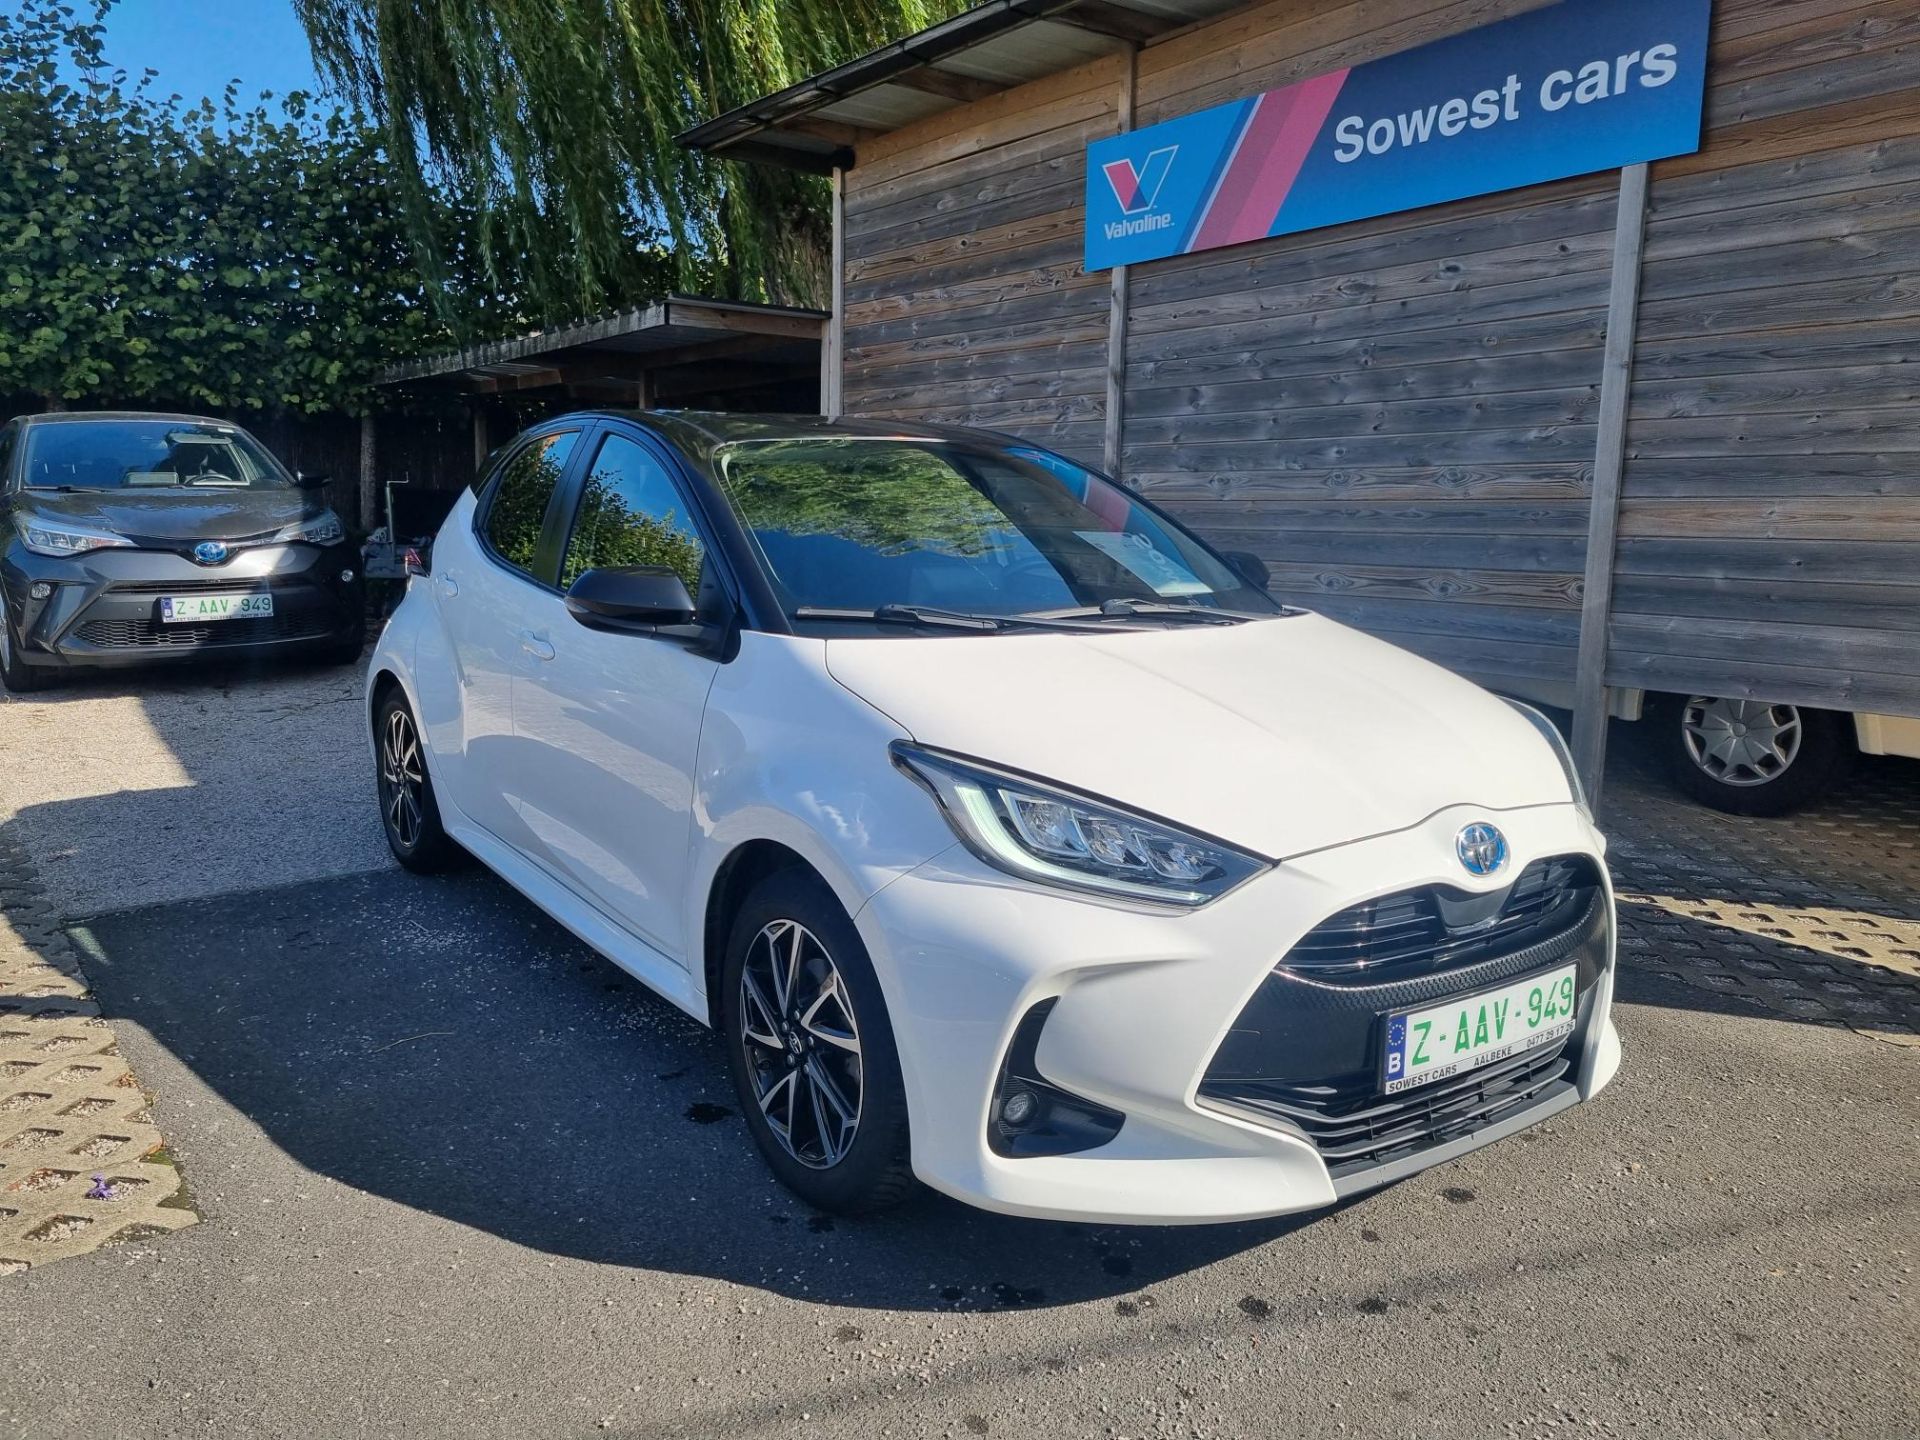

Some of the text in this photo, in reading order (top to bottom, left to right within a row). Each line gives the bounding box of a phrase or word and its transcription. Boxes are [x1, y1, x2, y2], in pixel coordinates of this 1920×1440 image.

[1333, 43, 1677, 163] Sowest cars
[1104, 213, 1171, 240] Valvoline
[1411, 976, 1573, 1066] Z-AAV-949
[1388, 1053, 1401, 1073] B
[1389, 1073, 1430, 1093] SOWEST
[1432, 1064, 1457, 1080] CARS
[1473, 1046, 1512, 1067] AALBEKE
[1526, 1034, 1544, 1048] 0477
